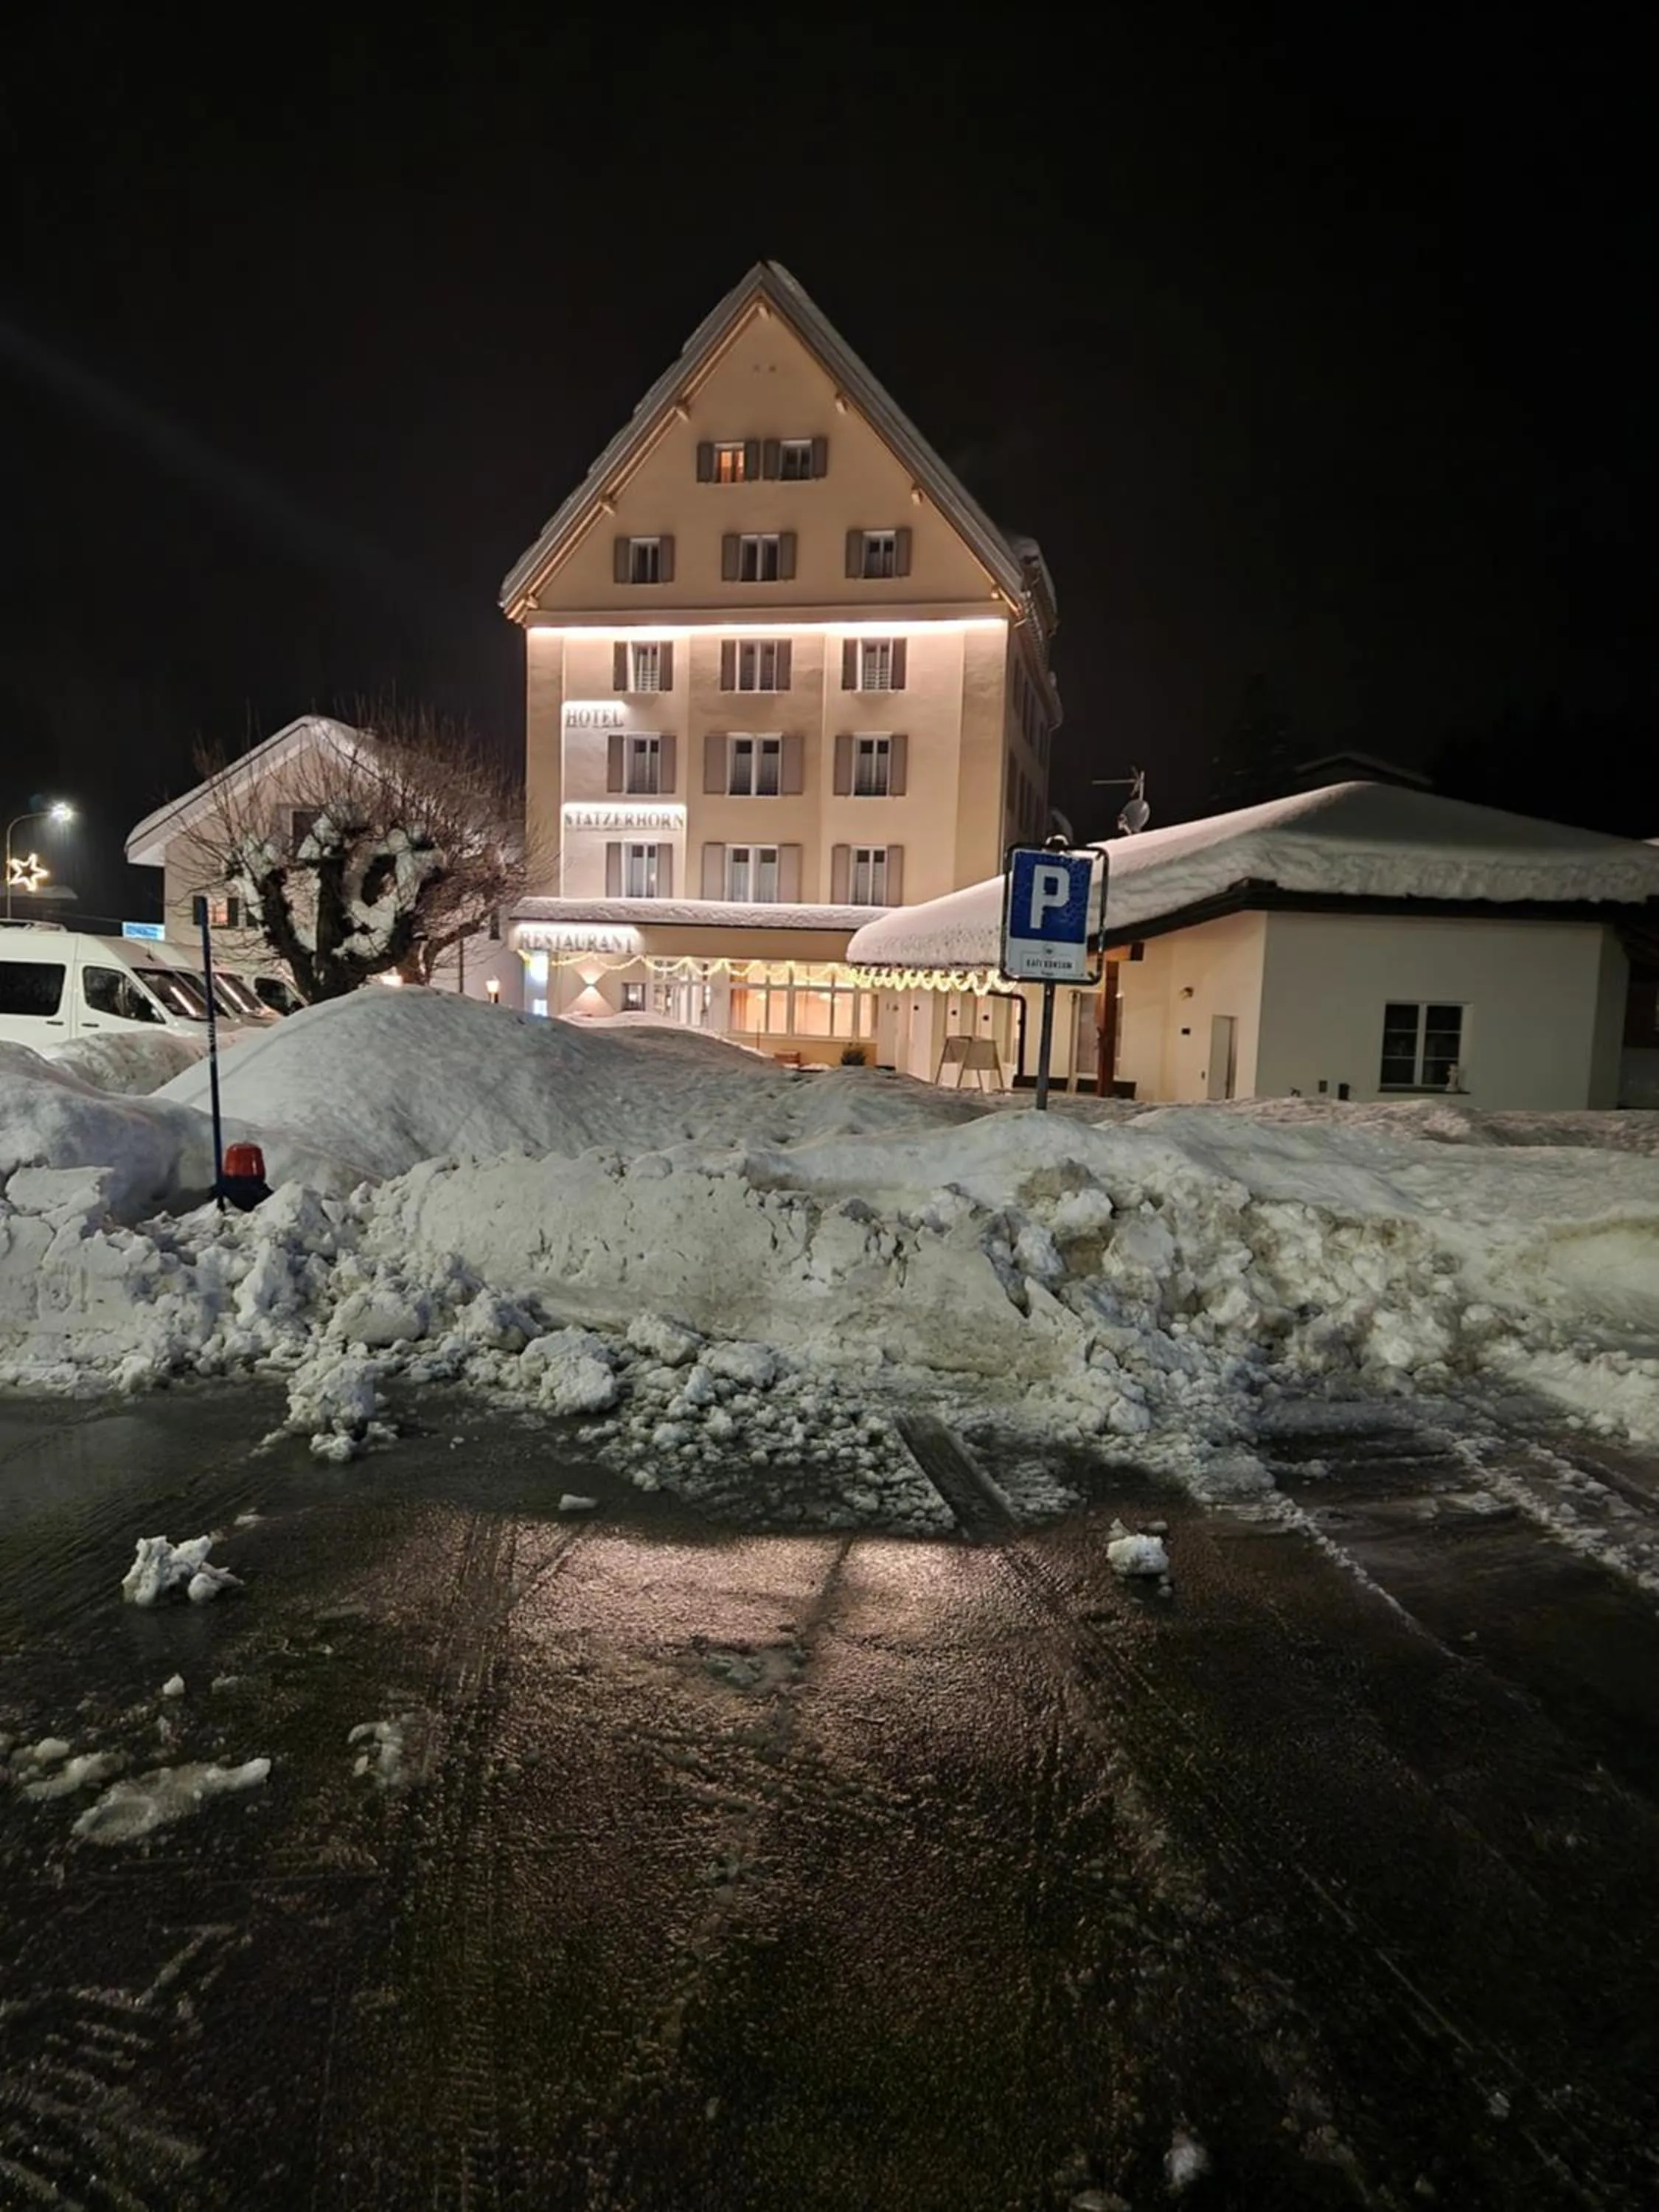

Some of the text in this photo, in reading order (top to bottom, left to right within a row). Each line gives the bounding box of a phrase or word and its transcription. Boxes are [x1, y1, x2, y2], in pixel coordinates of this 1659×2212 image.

[566, 709, 625, 728] HOTEL
[563, 810, 684, 827] STATZERHORN
[1029, 864, 1070, 929] P
[518, 930, 634, 953] RESTAURANT
